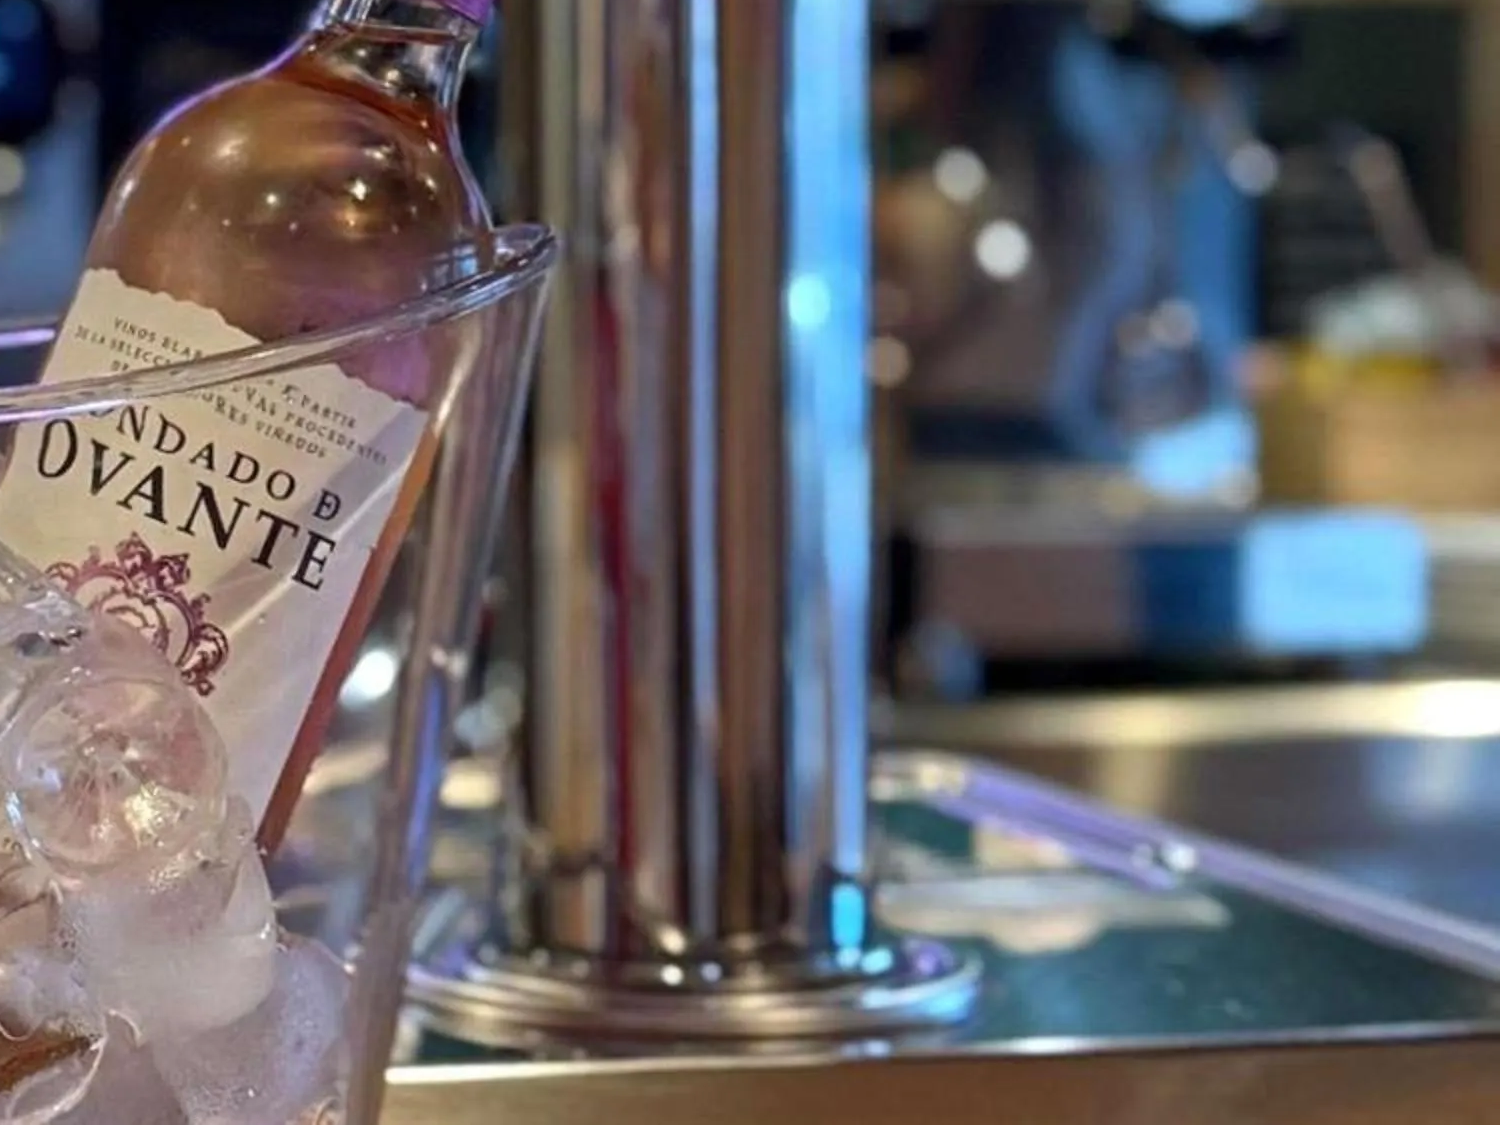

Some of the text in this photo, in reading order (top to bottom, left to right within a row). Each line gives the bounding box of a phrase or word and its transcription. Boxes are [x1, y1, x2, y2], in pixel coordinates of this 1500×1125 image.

[114, 316, 157, 344] VINOS
[301, 394, 357, 429] PARTIR
[37, 418, 336, 591] OVANTE
